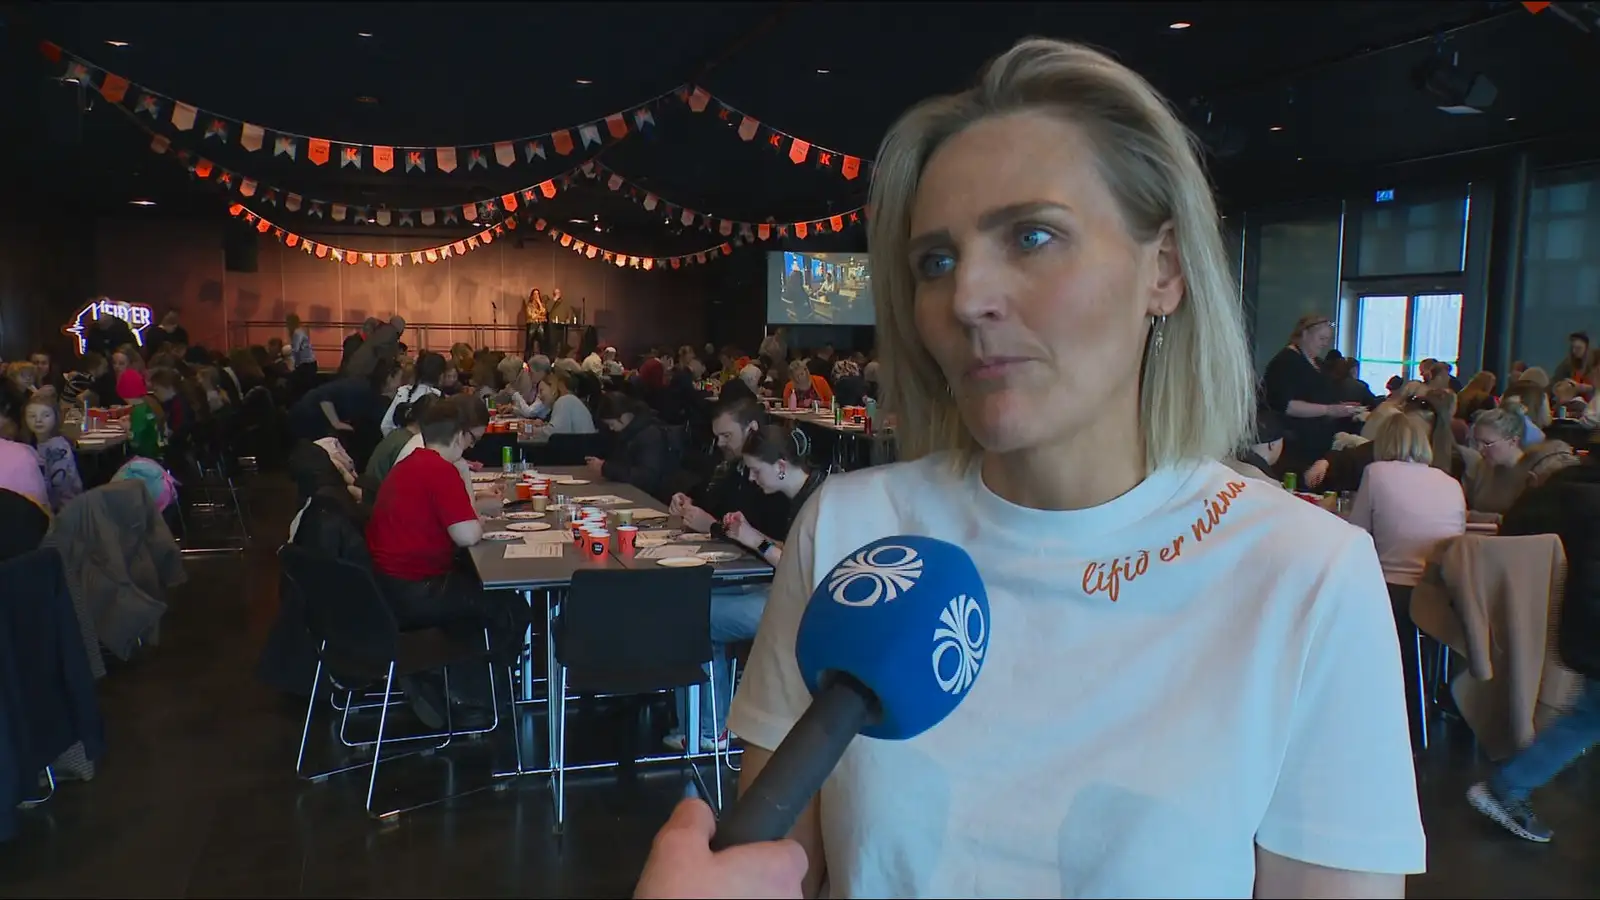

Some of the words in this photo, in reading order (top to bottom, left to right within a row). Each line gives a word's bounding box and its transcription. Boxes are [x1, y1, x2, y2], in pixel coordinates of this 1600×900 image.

[346, 147, 357, 160] K
[409, 152, 421, 165] K
[820, 152, 831, 166] K
[815, 222, 824, 232] K
[131, 306, 151, 325] ER
[1082, 550, 1150, 602] lífið
[1160, 535, 1184, 562] er
[1191, 481, 1246, 542] núna
